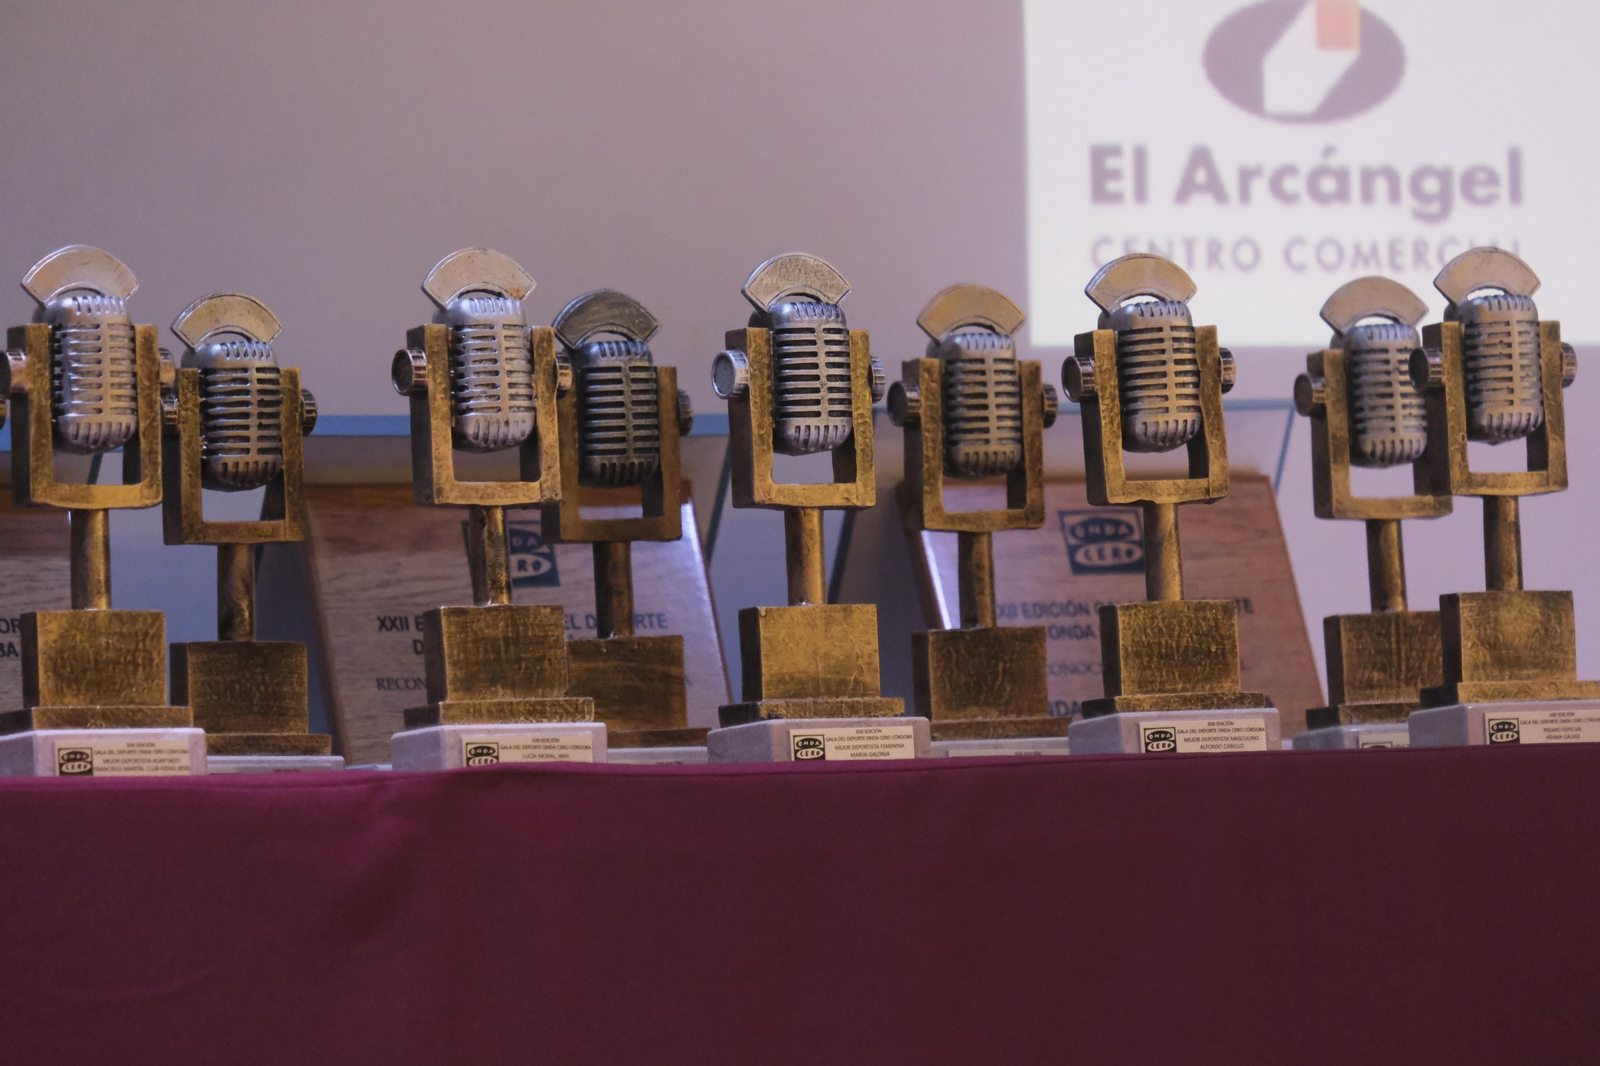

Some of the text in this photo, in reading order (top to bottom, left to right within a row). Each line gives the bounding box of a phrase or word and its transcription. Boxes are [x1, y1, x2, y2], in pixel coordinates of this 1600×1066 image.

[1089, 143, 1522, 225] El Arcángel
[1074, 522, 1130, 539] ONDA
[512, 537, 538, 548] DA
[1083, 547, 1135, 562] CERO
[517, 559, 542, 572] RO
[1021, 600, 1091, 619] EDICIÓN
[376, 615, 409, 632] XXII
[1047, 625, 1096, 640] ONDA
